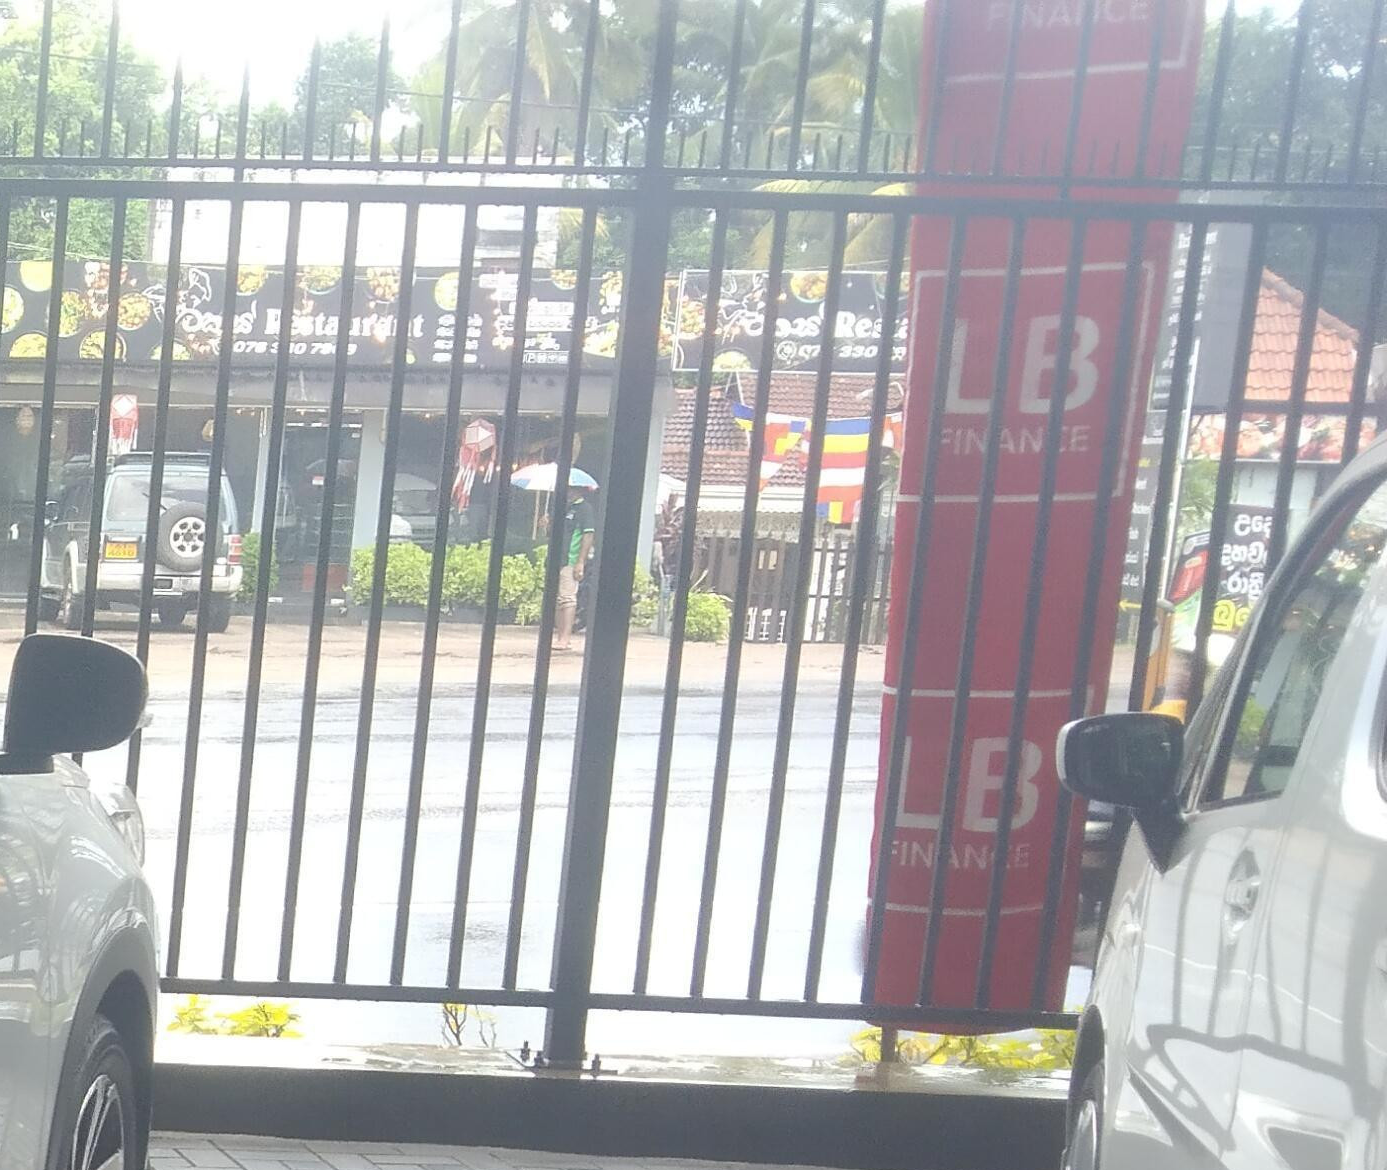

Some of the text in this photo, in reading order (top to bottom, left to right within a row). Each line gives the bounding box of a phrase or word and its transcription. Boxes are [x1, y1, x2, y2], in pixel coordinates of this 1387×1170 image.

[945, 314, 1100, 414] LB
[940, 424, 1092, 456] FINANE
[894, 735, 1043, 833] LB
[891, 840, 1031, 870] INANE
